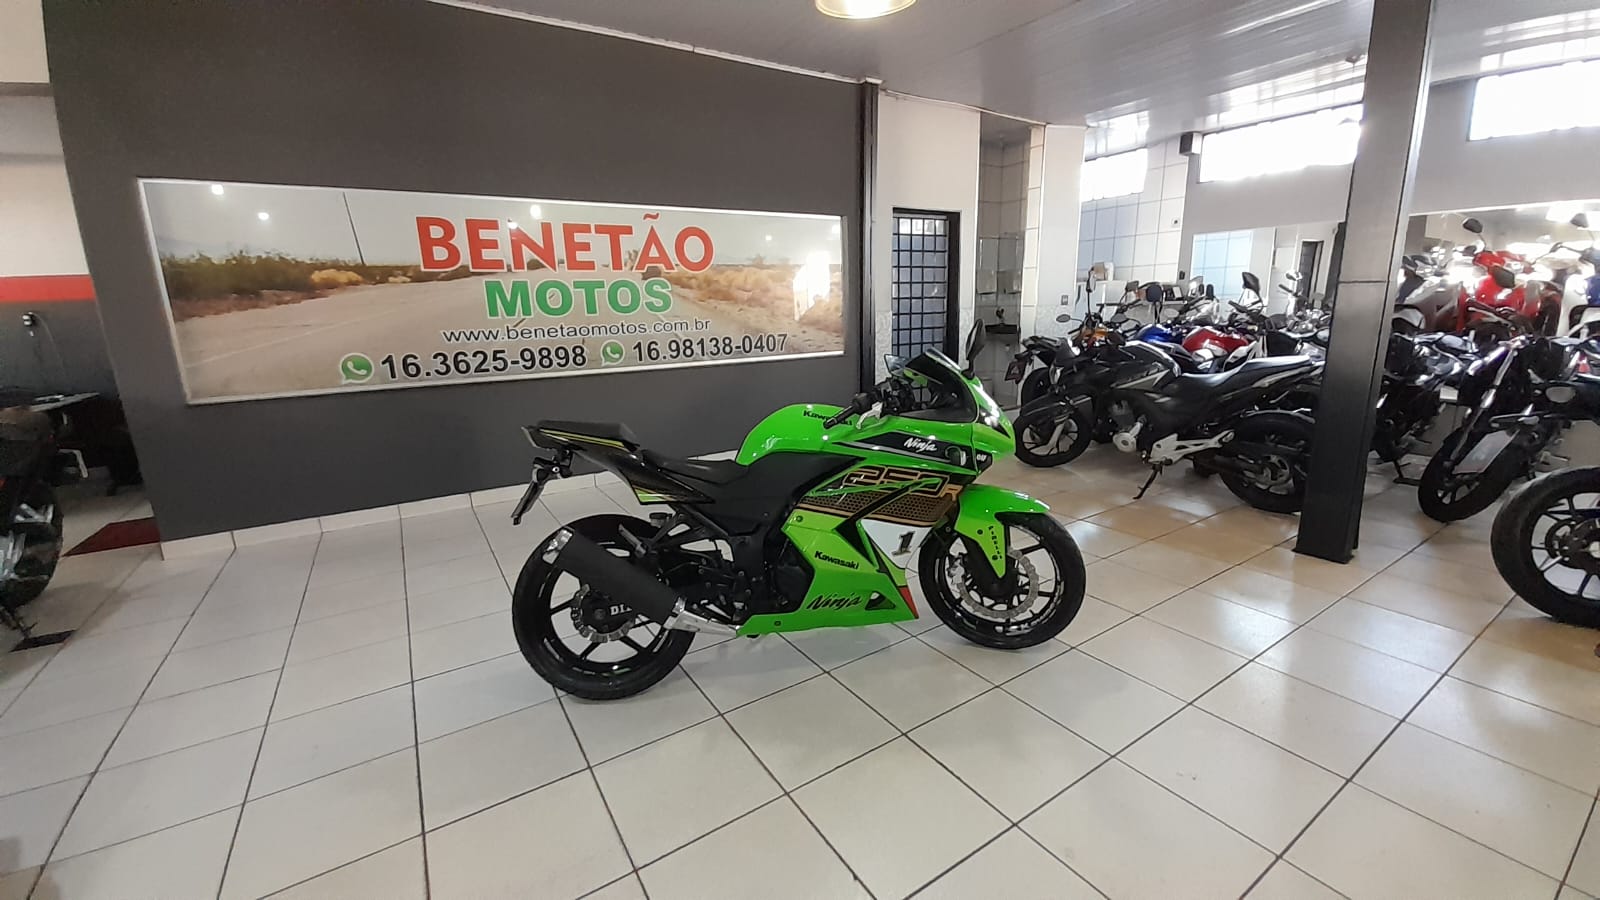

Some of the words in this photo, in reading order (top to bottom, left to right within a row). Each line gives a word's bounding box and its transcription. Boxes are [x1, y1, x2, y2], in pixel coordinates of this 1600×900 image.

[416, 213, 714, 272] BENETÃO
[485, 279, 673, 318] MOTOS
[443, 319, 711, 342] www.benetaomotos.com.br
[632, 334, 788, 361] 16.98138-0407
[382, 345, 587, 379] 16.3625-9898
[903, 437, 937, 452] Ninja
[892, 530, 916, 557] 1
[814, 550, 859, 569] Kawasaki
[806, 592, 862, 610] Ninja
